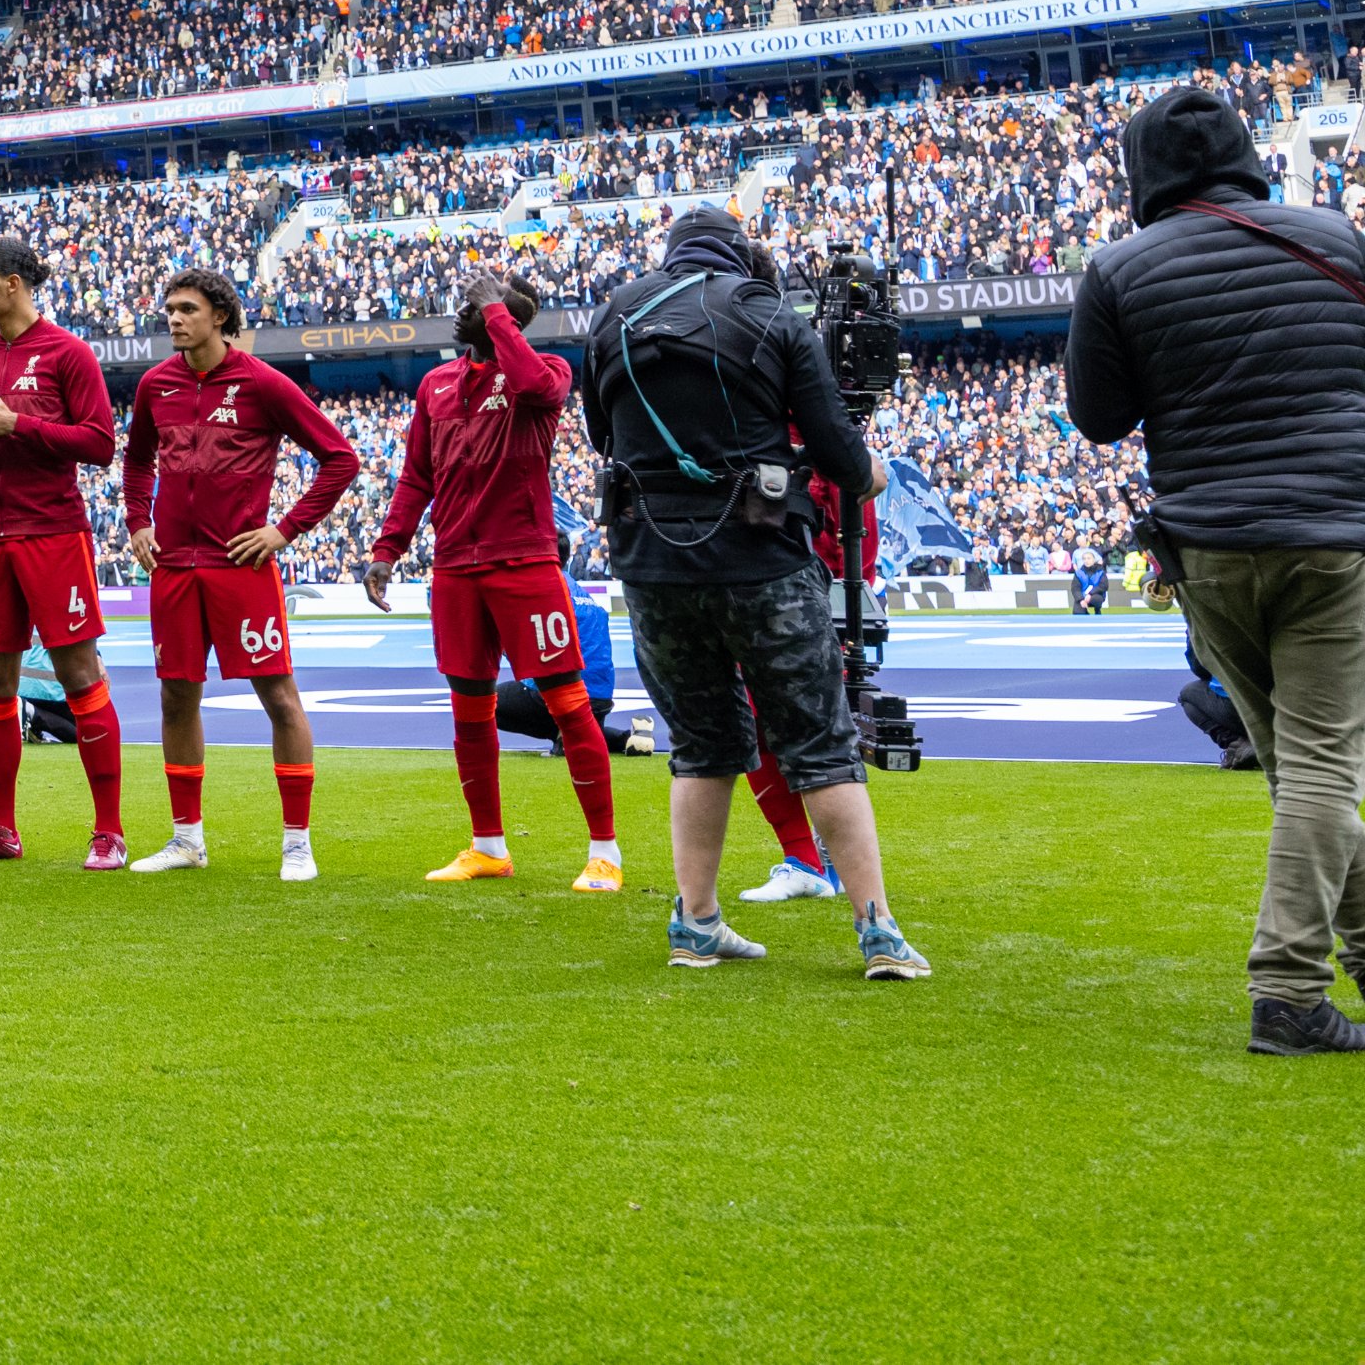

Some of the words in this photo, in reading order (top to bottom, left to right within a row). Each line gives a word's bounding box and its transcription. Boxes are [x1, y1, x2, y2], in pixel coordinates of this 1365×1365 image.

[508, 63, 549, 82] AND
[554, 59, 582, 76] ON
[589, 52, 630, 73] THE
[635, 46, 698, 68] SIXTH
[704, 42, 744, 60] DAY
[750, 35, 798, 55] GOD
[805, 22, 909, 48] CREATED
[915, 2, 1077, 34] MANCHESTER
[154, 102, 183, 120] LIVE
[185, 99, 208, 118] FOR
[211, 96, 245, 116] CITY
[48, 114, 84, 133] SINCE
[1318, 113, 1348, 126] 205
[771, 165, 788, 177] 20
[531, 186, 552, 198] 20
[312, 205, 334, 218] 202
[940, 277, 1075, 311] STADIUM
[301, 325, 416, 348] ETIHAD
[90, 336, 153, 361] DIUM
[10, 376, 38, 391] AXA
[477, 394, 509, 412] AXA
[206, 407, 238, 425] AXA
[68, 586, 86, 617] 4
[240, 616, 283, 654] 66
[530, 611, 570, 650] 10
